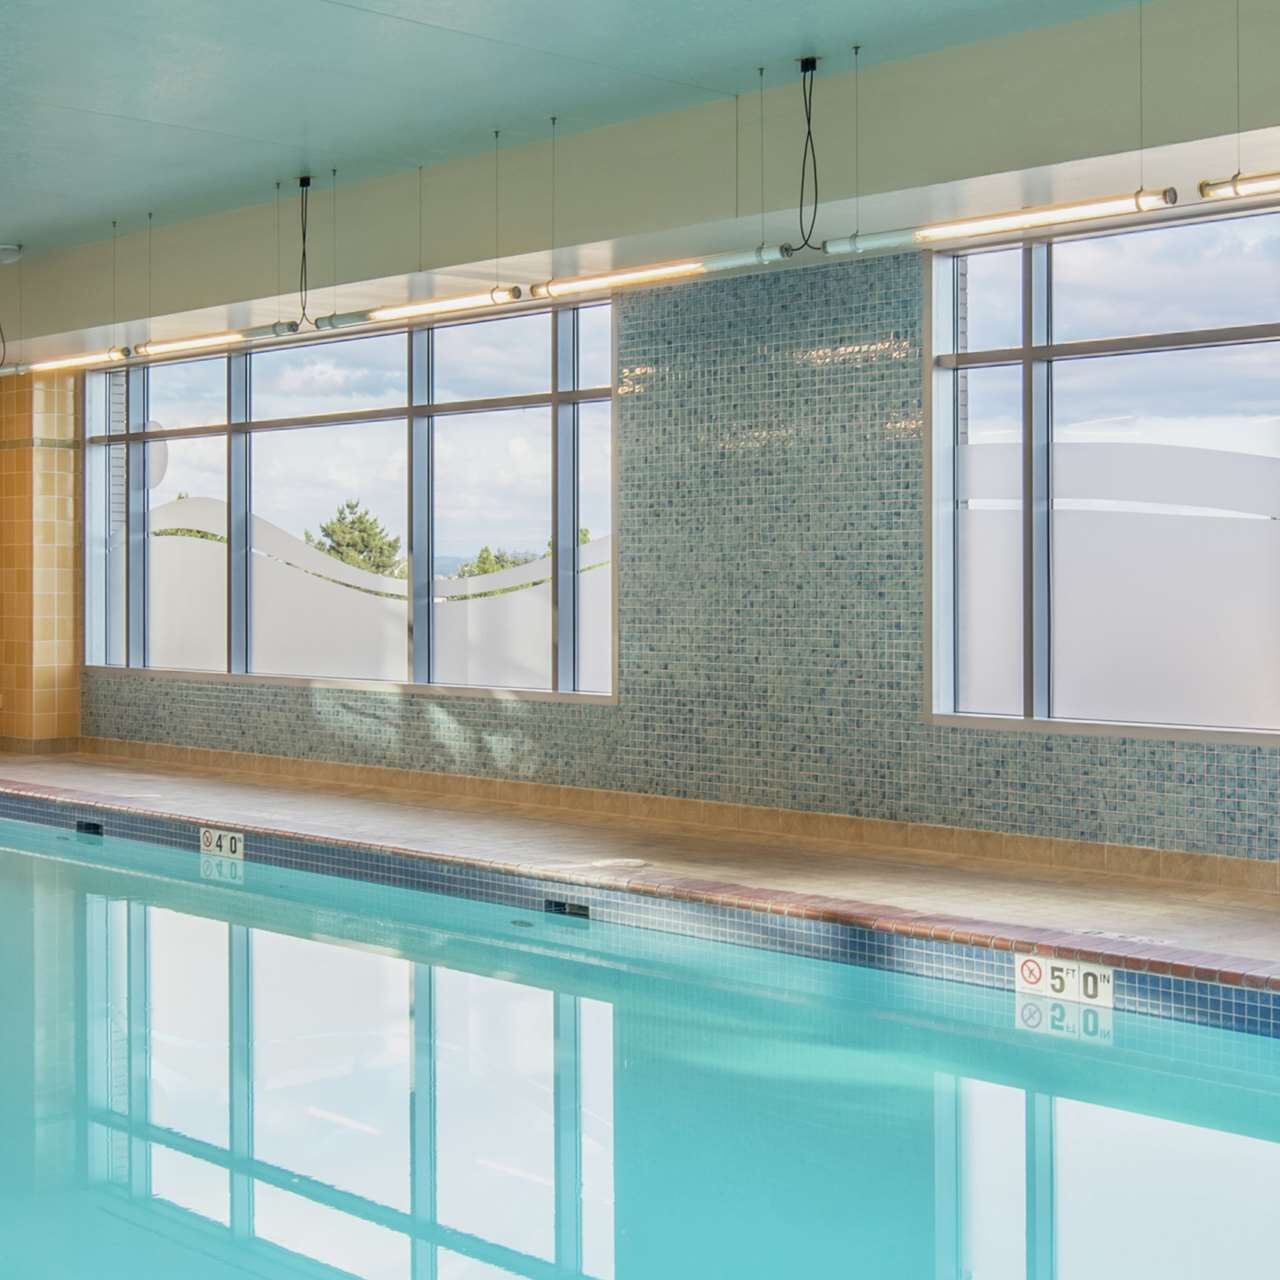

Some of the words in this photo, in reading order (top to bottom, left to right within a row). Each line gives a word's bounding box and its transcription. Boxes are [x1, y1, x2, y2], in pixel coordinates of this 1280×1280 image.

[215, 834, 223, 852] 4
[230, 836, 237, 854] 0
[1050, 966, 1065, 993] 5
[1066, 968, 1076, 979] FT
[1082, 972, 1098, 999] 0
[1100, 973, 1110, 984] IN
